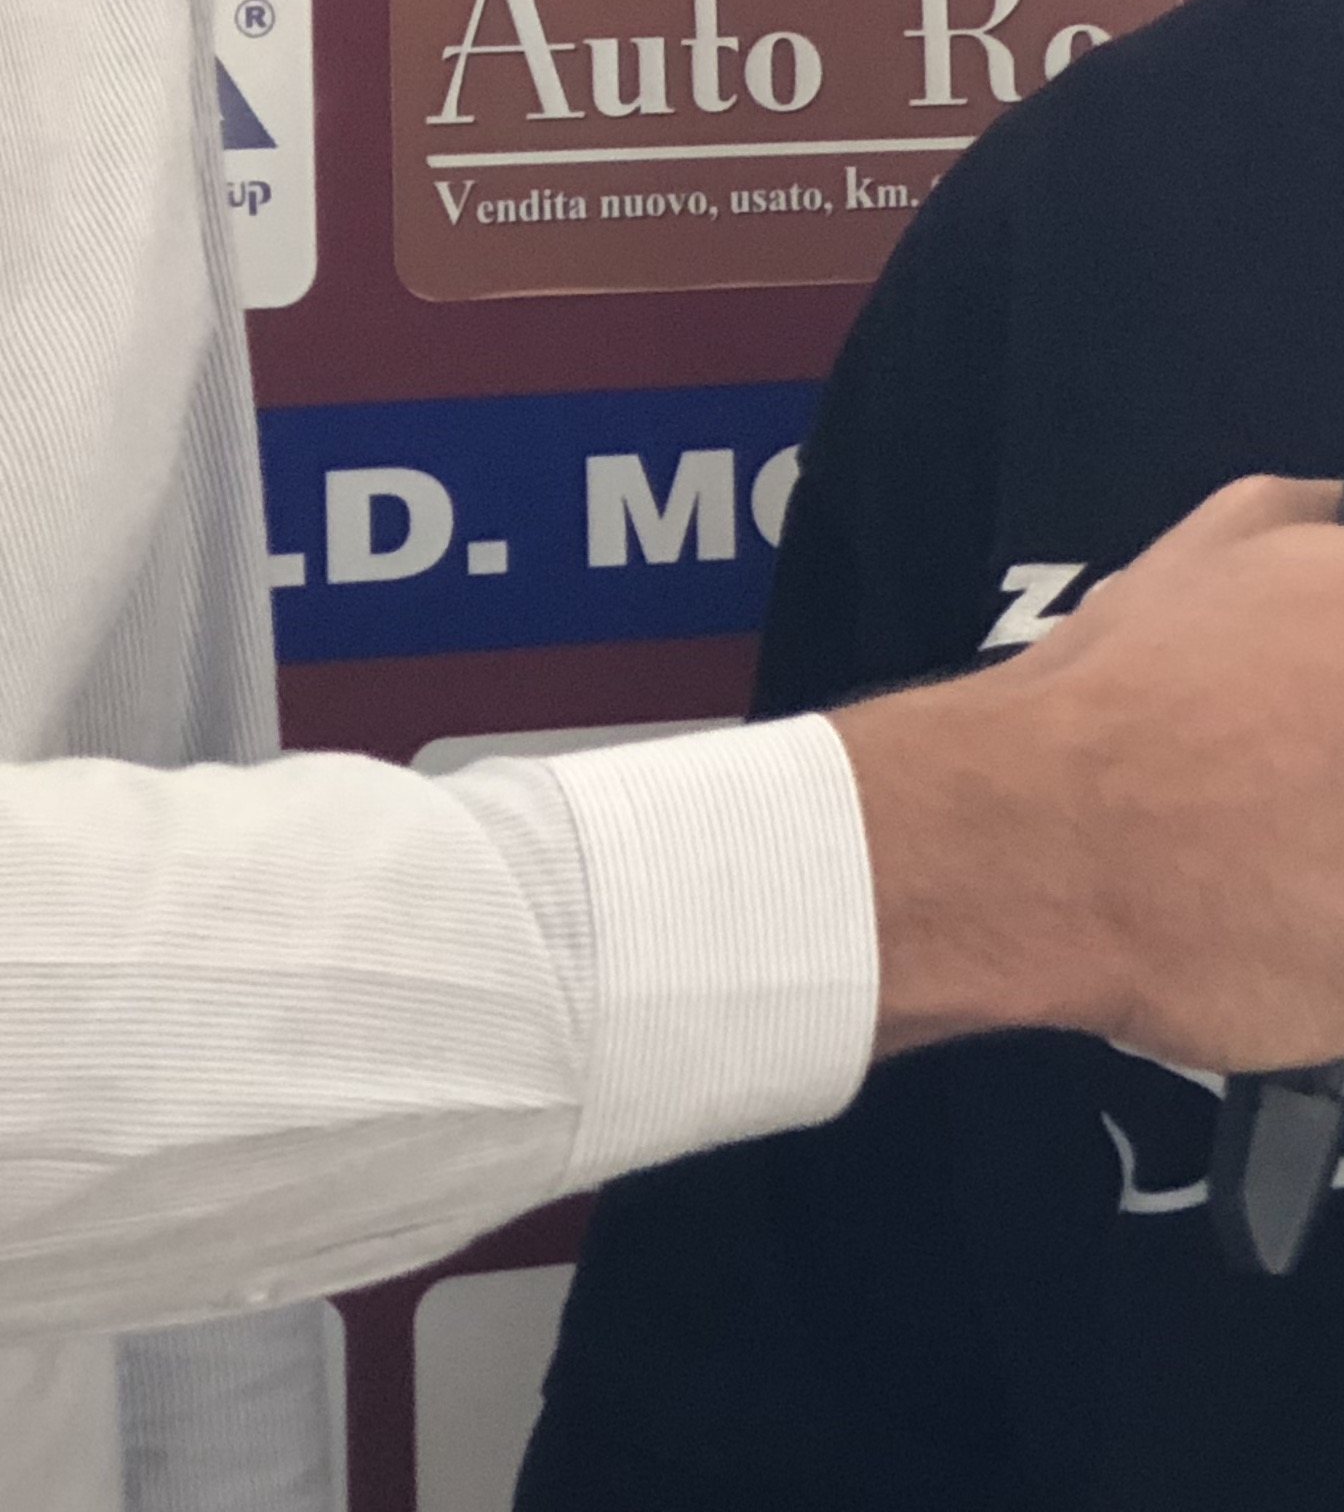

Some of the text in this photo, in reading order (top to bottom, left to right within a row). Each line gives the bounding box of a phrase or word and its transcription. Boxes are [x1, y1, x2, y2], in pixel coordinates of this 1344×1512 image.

[434, 178, 588, 227] Vendita
[600, 187, 720, 221] nuovo,
[730, 181, 834, 217] usato,
